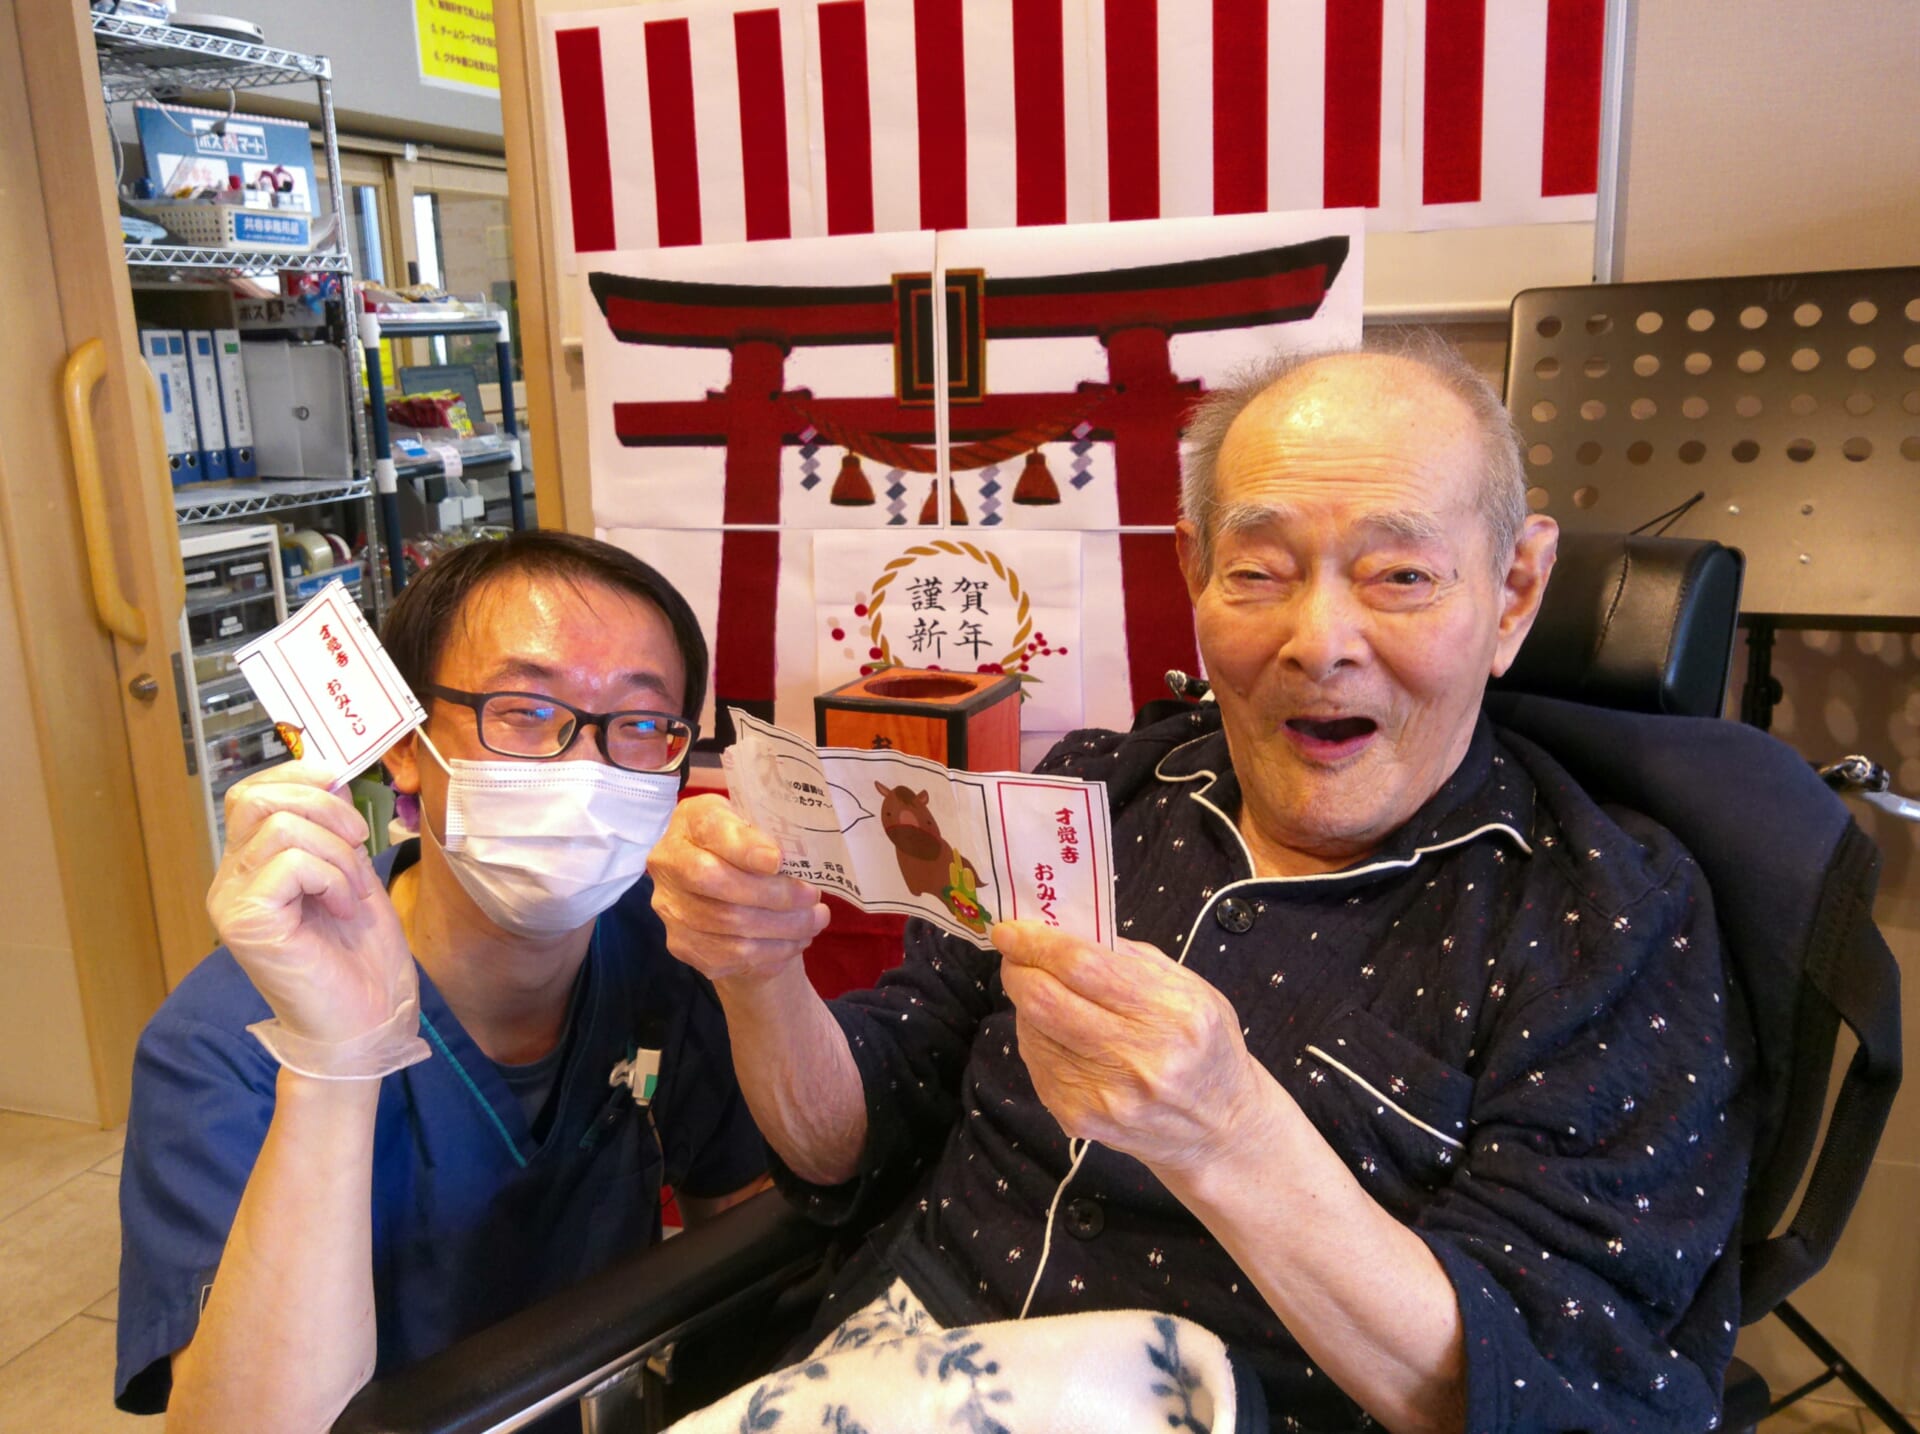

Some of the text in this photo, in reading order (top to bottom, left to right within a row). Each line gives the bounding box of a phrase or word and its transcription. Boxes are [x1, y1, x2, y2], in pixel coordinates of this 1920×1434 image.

[905, 576, 989, 615] 謹賀
[907, 617, 993, 661] 新年
[326, 678, 367, 736] おみくじ
[1034, 862, 1060, 927] おみく
